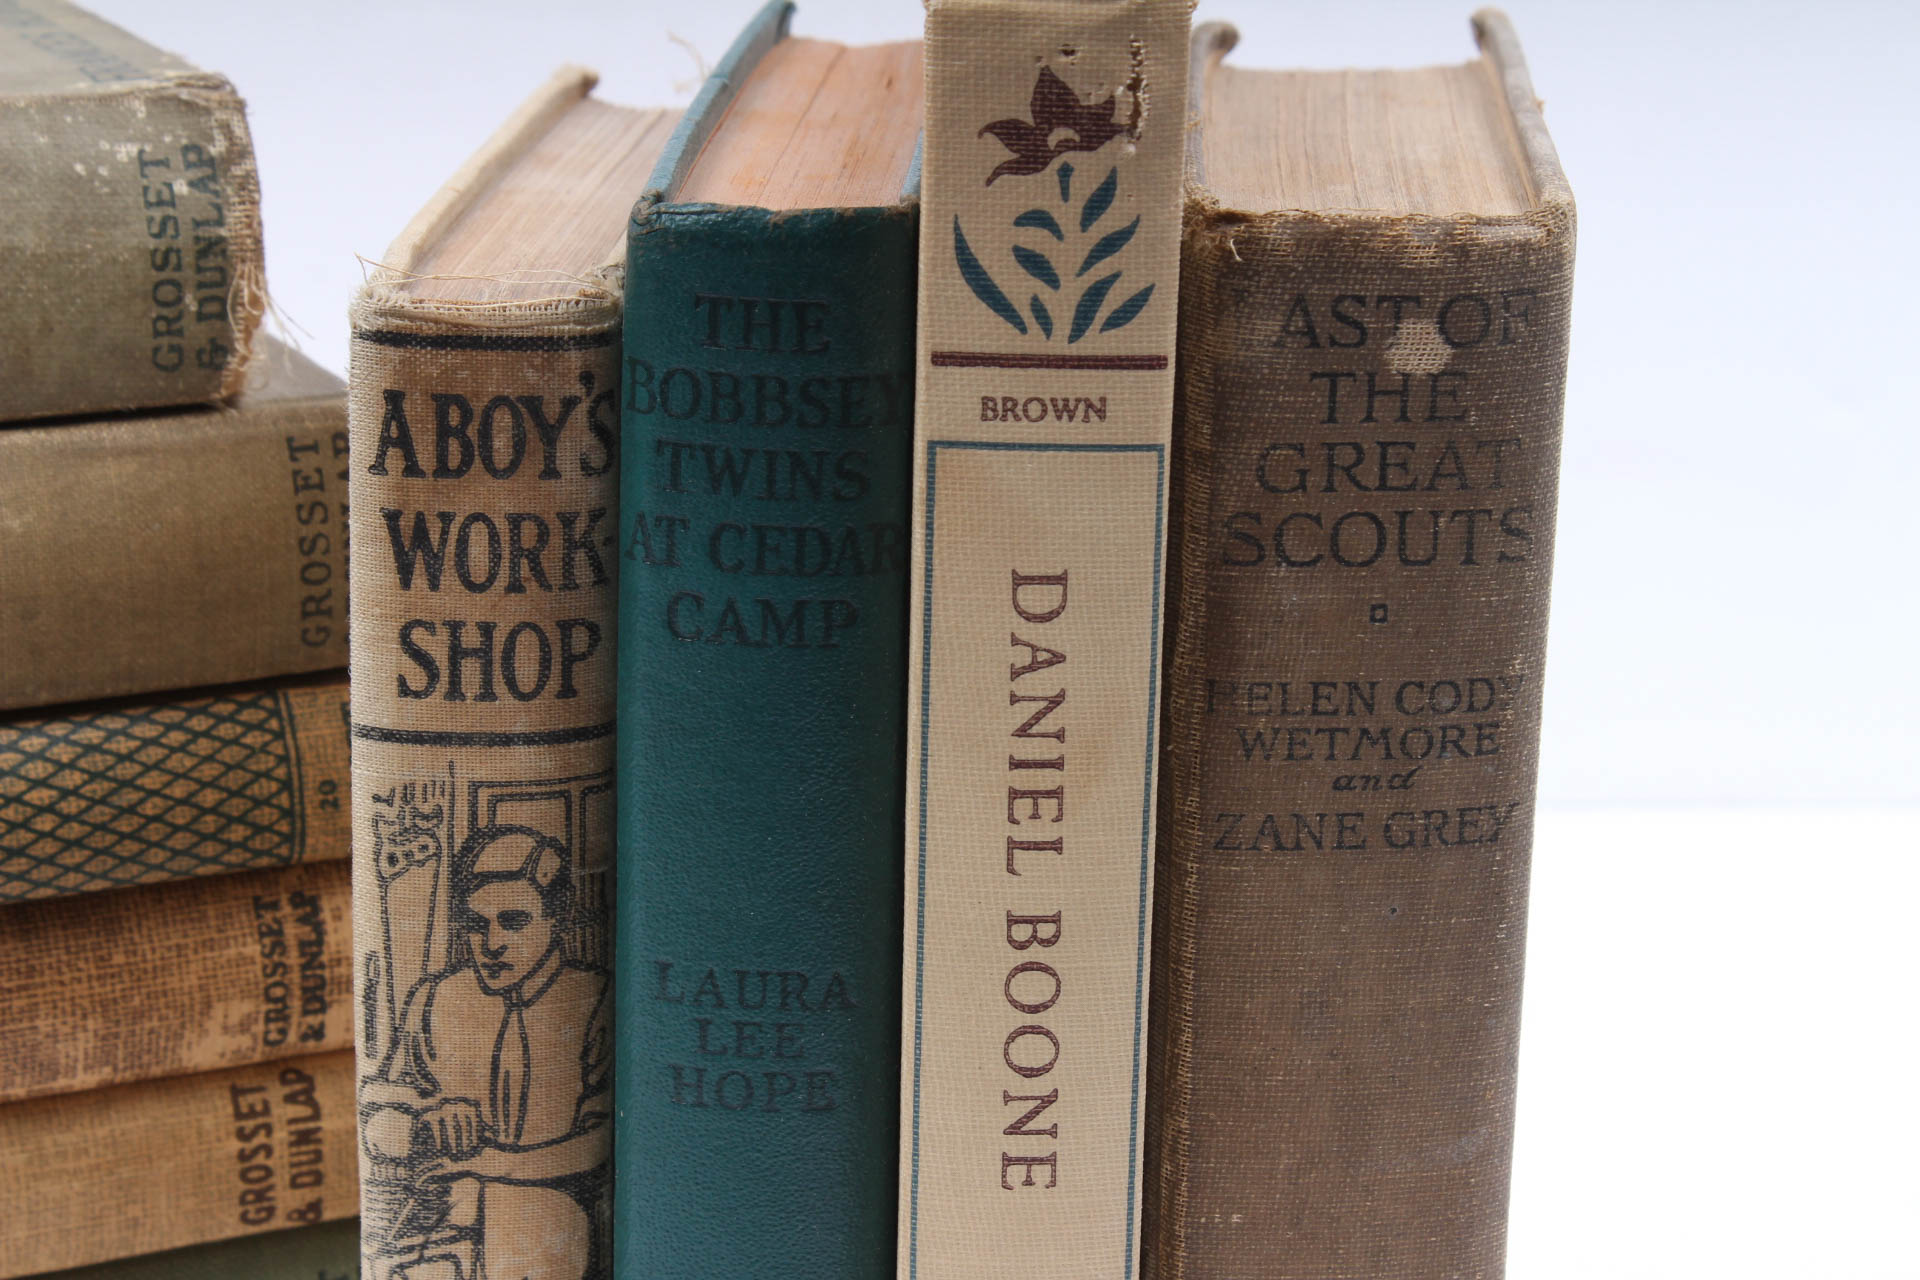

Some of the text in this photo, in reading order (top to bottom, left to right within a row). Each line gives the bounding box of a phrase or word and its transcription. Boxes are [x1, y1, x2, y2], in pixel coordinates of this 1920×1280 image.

[137, 148, 185, 374] GROSSET
[181, 143, 229, 372] & DUNLAP
[695, 292, 832, 354] THE
[1438, 289, 1538, 349] OF
[368, 370, 615, 480] A BOY'S
[980, 395, 1107, 424] BROWN
[1310, 371, 1468, 424] THE
[657, 437, 871, 501] TWINS
[1256, 438, 1522, 493] GREAT
[286, 436, 333, 648] GROSSET
[624, 510, 905, 577] AT CEDAR
[1222, 505, 1536, 568] SCOUTS
[666, 590, 858, 648] CAMP
[397, 617, 600, 702] SHOP
[1234, 722, 1501, 762] WETMORE
[1332, 766, 1423, 792] and
[1213, 801, 1520, 851] ZANE GREY
[1001, 568, 1069, 1192] DANIEL BOONE
[252, 895, 290, 1048] GROSSET
[287, 891, 328, 1016] DUNLAP
[654, 960, 857, 1012] LAURA
[693, 1017, 806, 1059] LEE
[668, 1063, 842, 1113] HOPE
[229, 1082, 276, 1226] GROSSET
[278, 1067, 324, 1225] & DUNLAP
